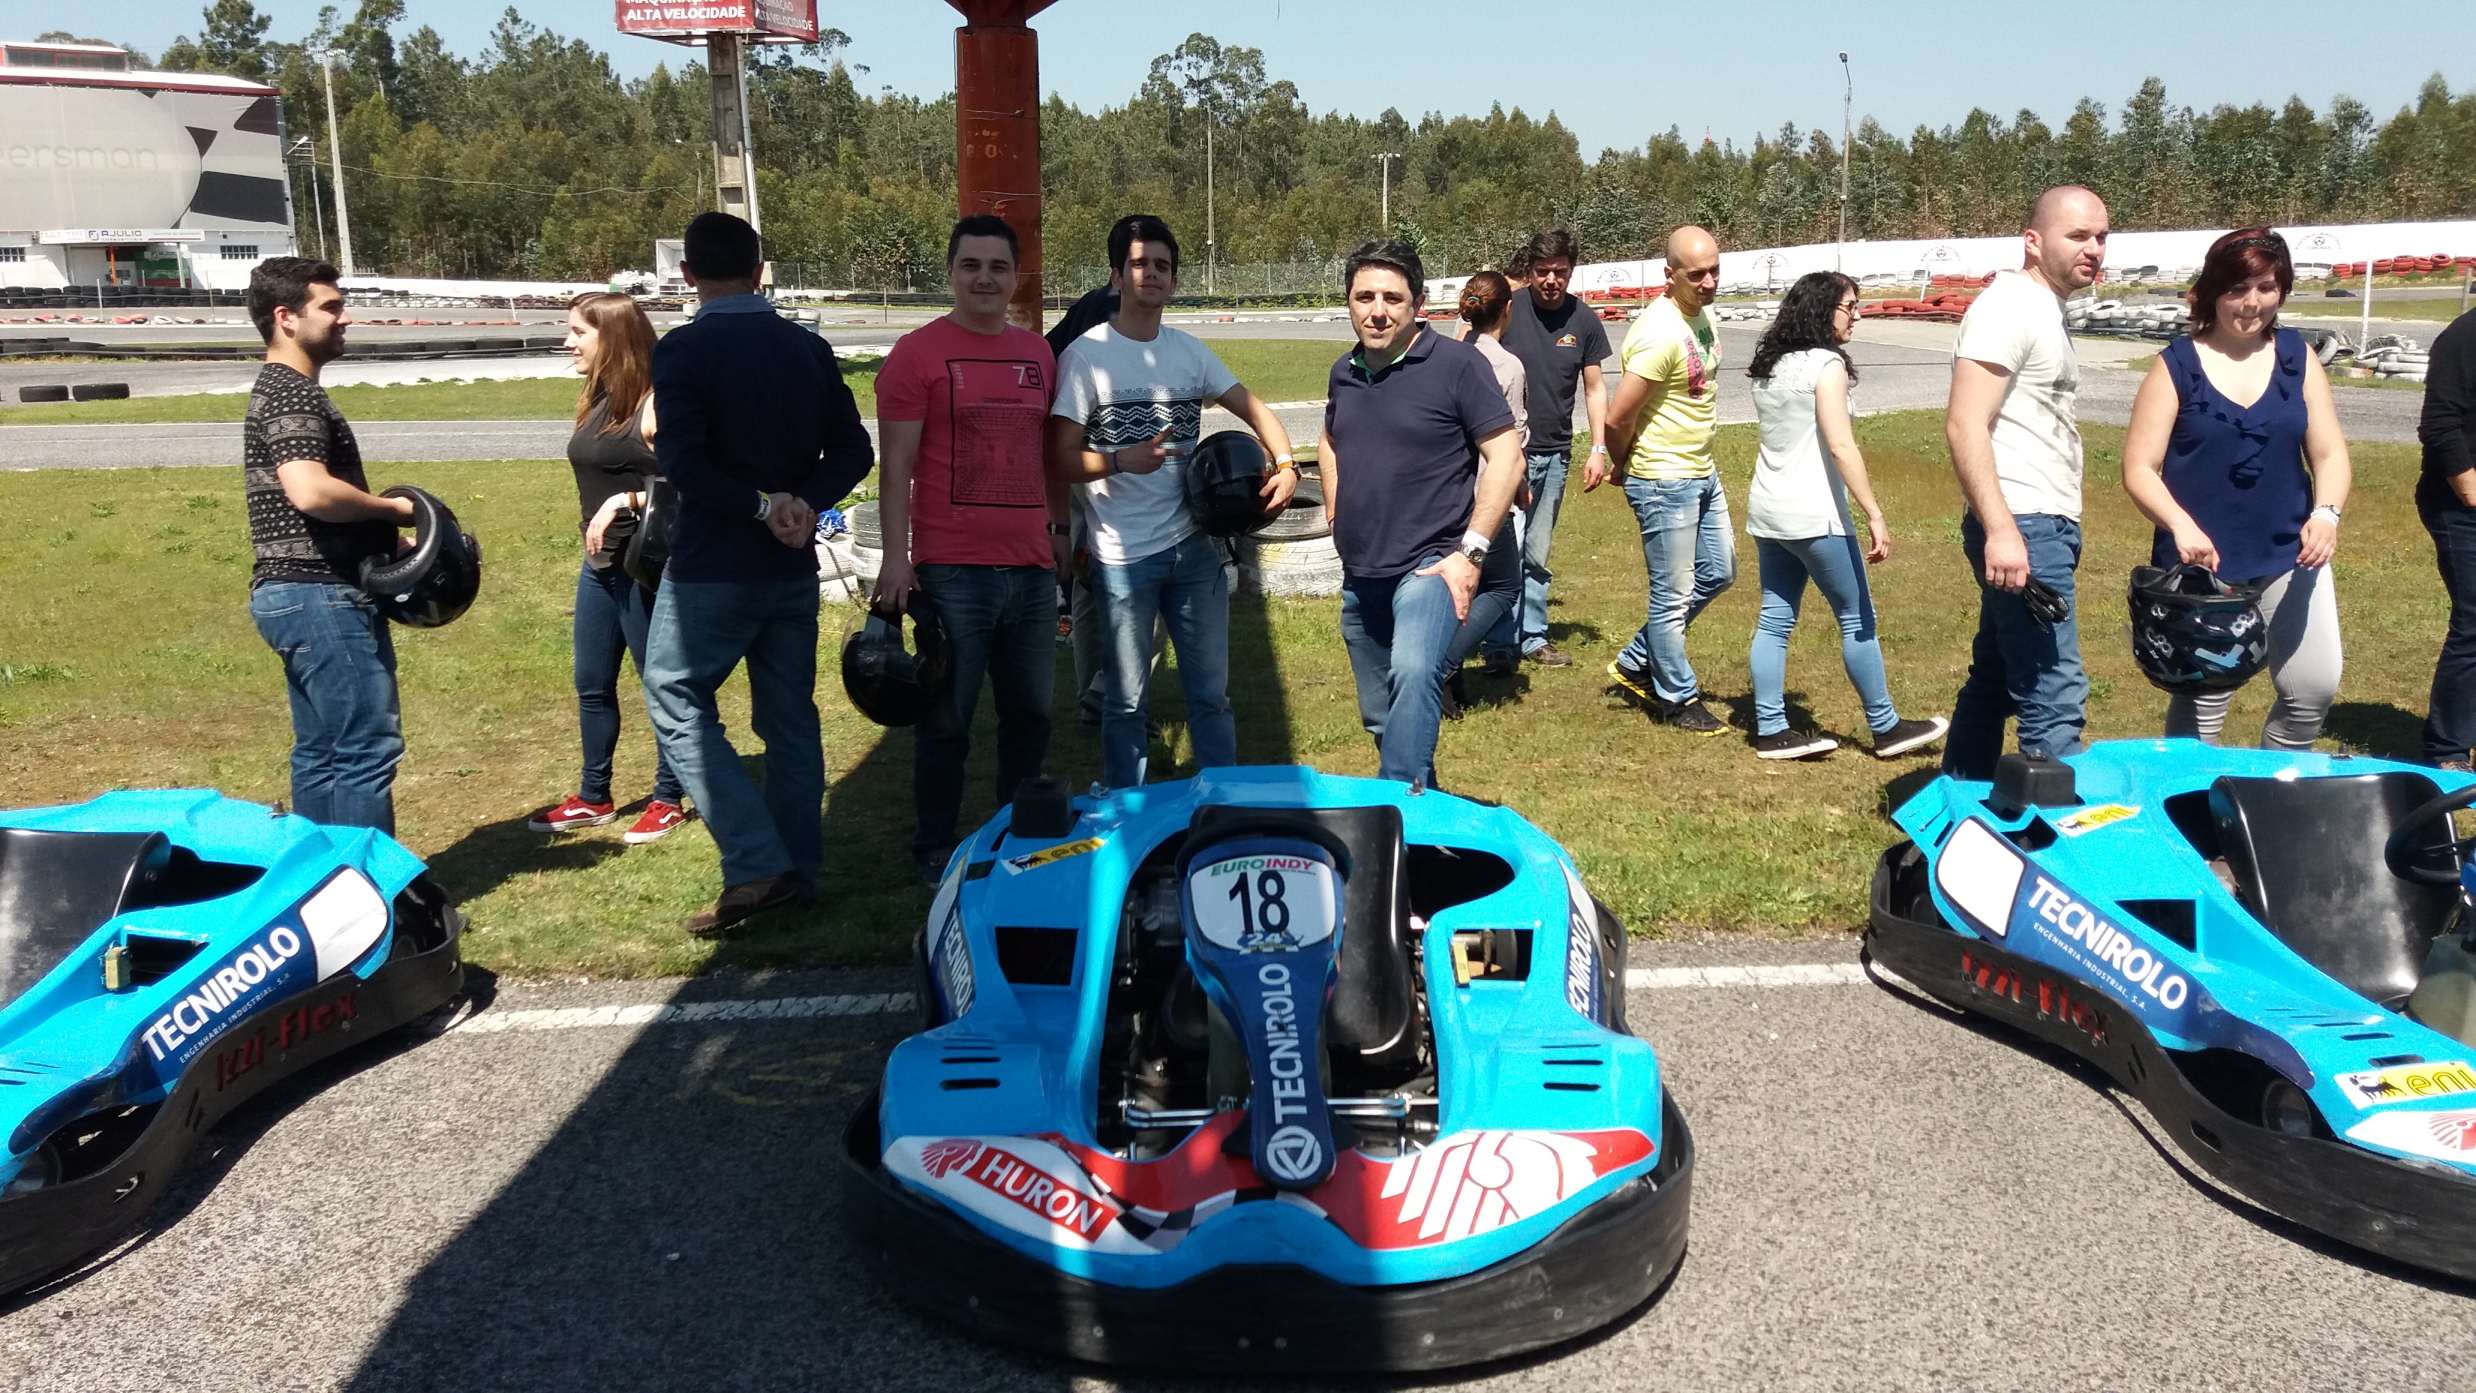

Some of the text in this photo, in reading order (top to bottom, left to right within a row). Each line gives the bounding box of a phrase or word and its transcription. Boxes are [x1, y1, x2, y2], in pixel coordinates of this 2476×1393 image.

[626, 8, 662, 21] ALTA
[664, 6, 746, 20] VELOCIDADE
[0, 145, 159, 168] ersman
[1229, 869, 1290, 936] 18
[1568, 913, 1592, 1019] ECNIROLO
[2028, 876, 2188, 1010] TECNIROLO
[2033, 922, 2081, 962] ENGENHARIA
[141, 927, 300, 1061] TECNIROLO
[179, 1022, 227, 1064] ENGENHARIA
[1258, 963, 1308, 1125] TECNIROLO
[980, 1151, 1103, 1234] HURON
